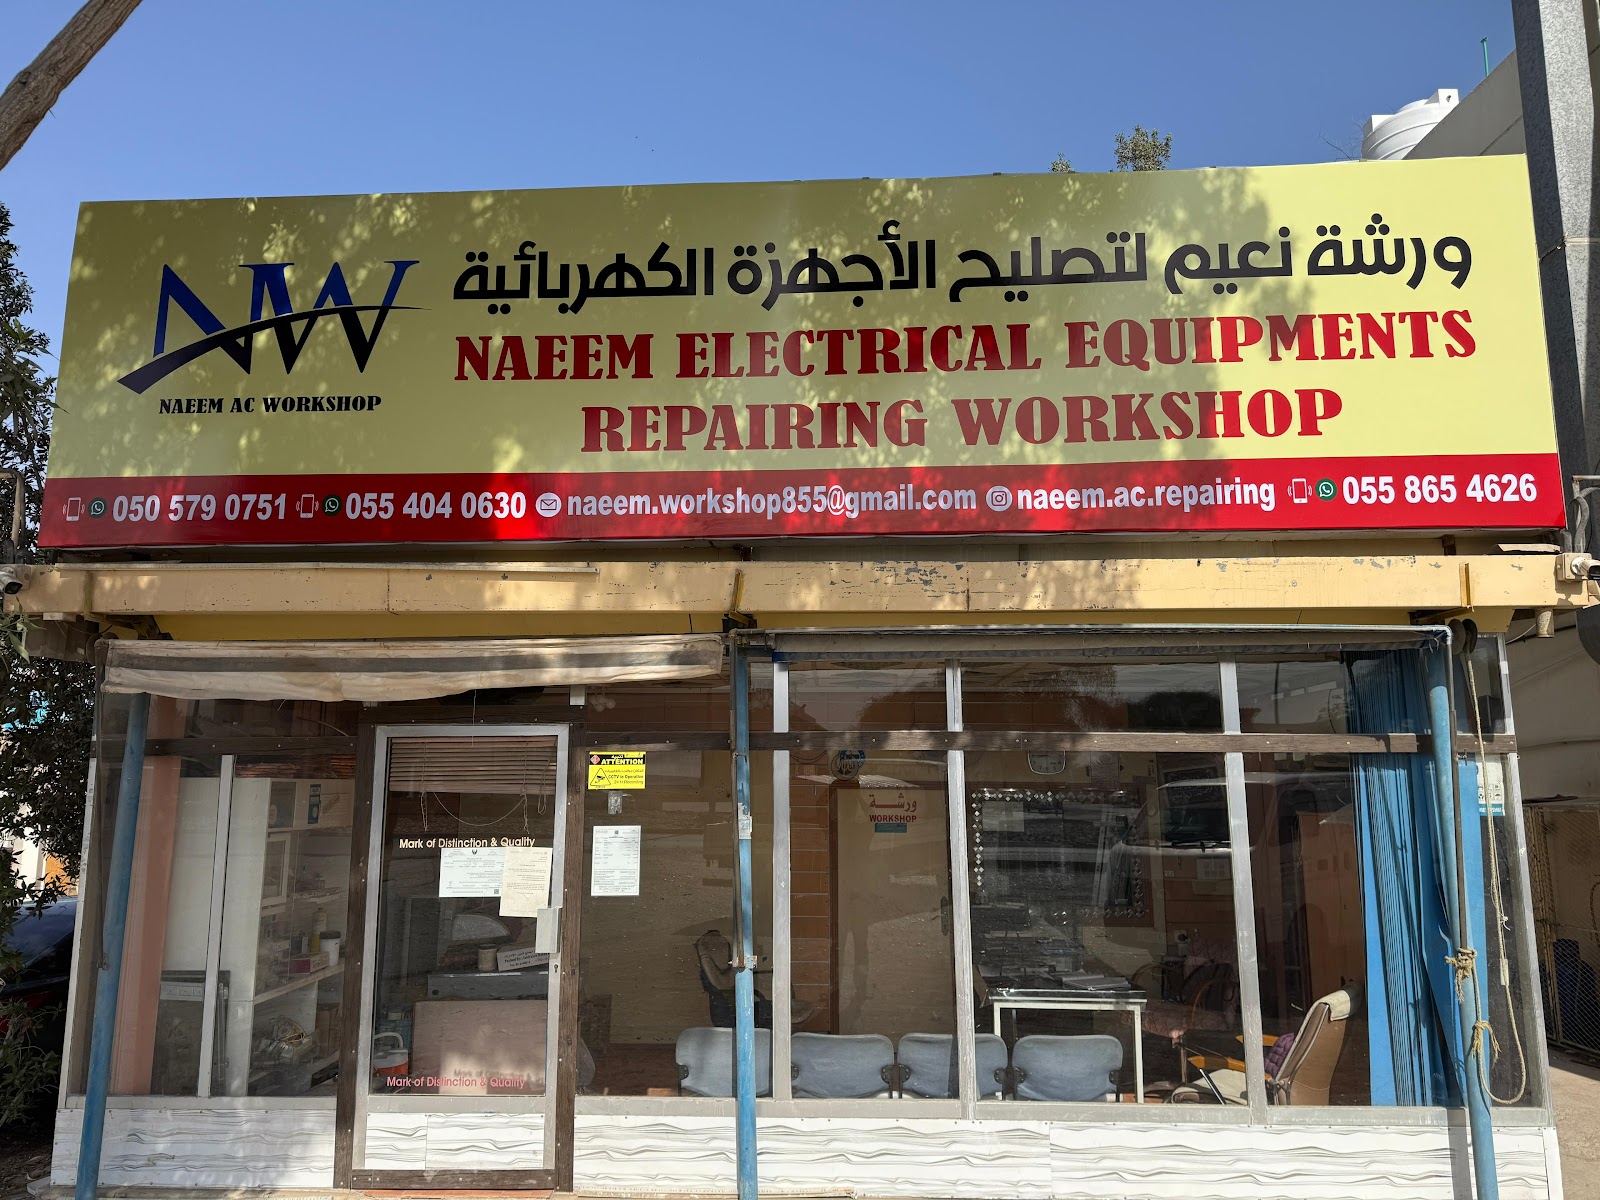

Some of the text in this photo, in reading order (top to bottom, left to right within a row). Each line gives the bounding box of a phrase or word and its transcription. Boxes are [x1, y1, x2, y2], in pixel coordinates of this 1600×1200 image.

[453, 213, 1472, 315] ورشة نعيم لتصليح الأجهزة الكهربائية
[454, 309, 1477, 381] NAEEM ELECTRICAL EQUIPMENTS
[159, 395, 382, 414] NAEEM AC WORKSHOP
[580, 388, 1343, 453] REPAIRING WORKSHOP
[567, 484, 977, 520] naeem.workshop855@gmail.com
[1017, 477, 1276, 513] naeem.ac.repairing
[1342, 473, 1538, 504] 055 865 4626
[112, 493, 287, 522] 050 579 0751
[345, 490, 527, 519] 055 404 0630
[868, 814, 917, 823] WORKSHOP
[399, 836, 535, 849] Mark of Distinction & Quality
[386, 1076, 526, 1089] Mark of Distinction & Quality
